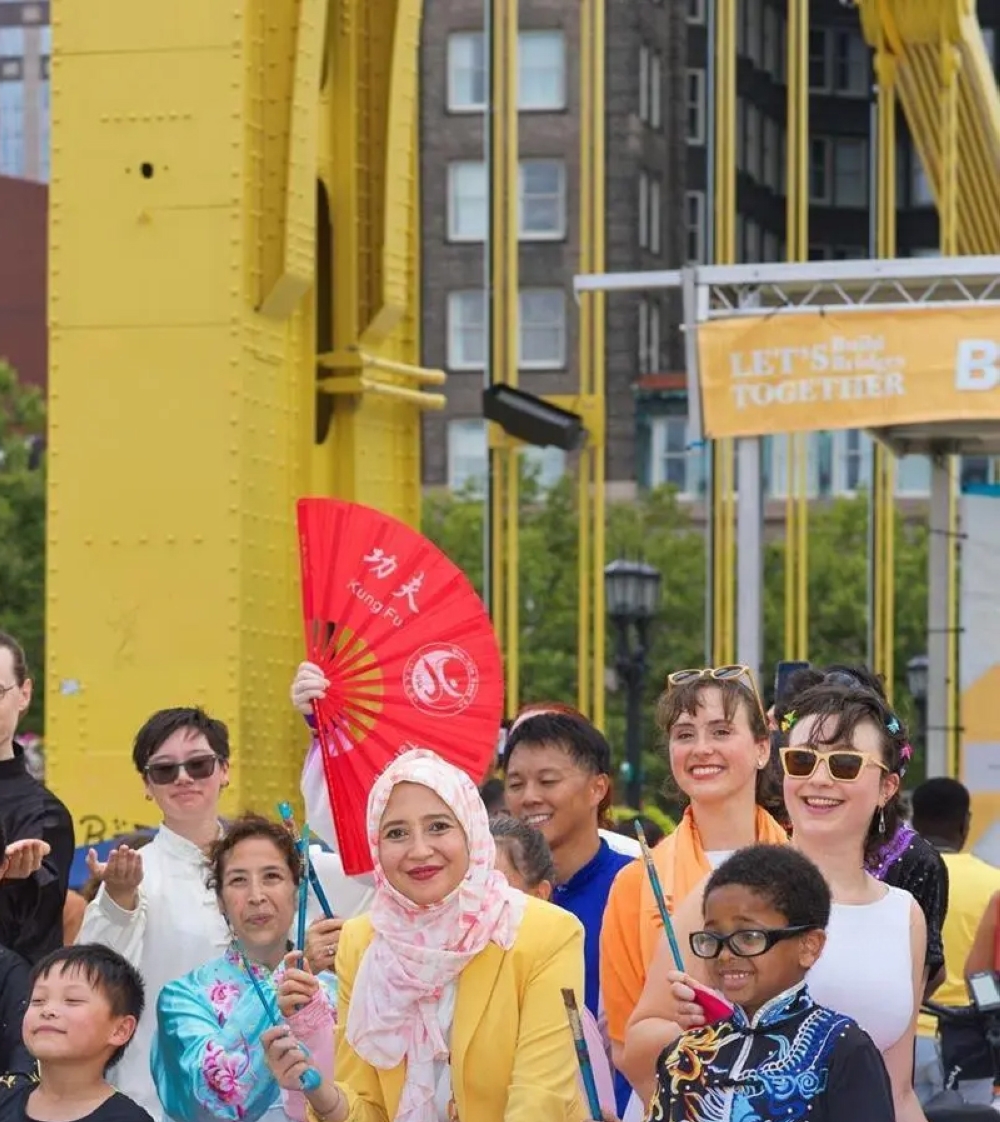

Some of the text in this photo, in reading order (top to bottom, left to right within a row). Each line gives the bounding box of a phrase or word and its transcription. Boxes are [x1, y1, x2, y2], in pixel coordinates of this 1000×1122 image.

[730, 346, 830, 376] LET'S
[732, 375, 905, 409] TOGETHER
[346, 578, 405, 627] Kung Fu
